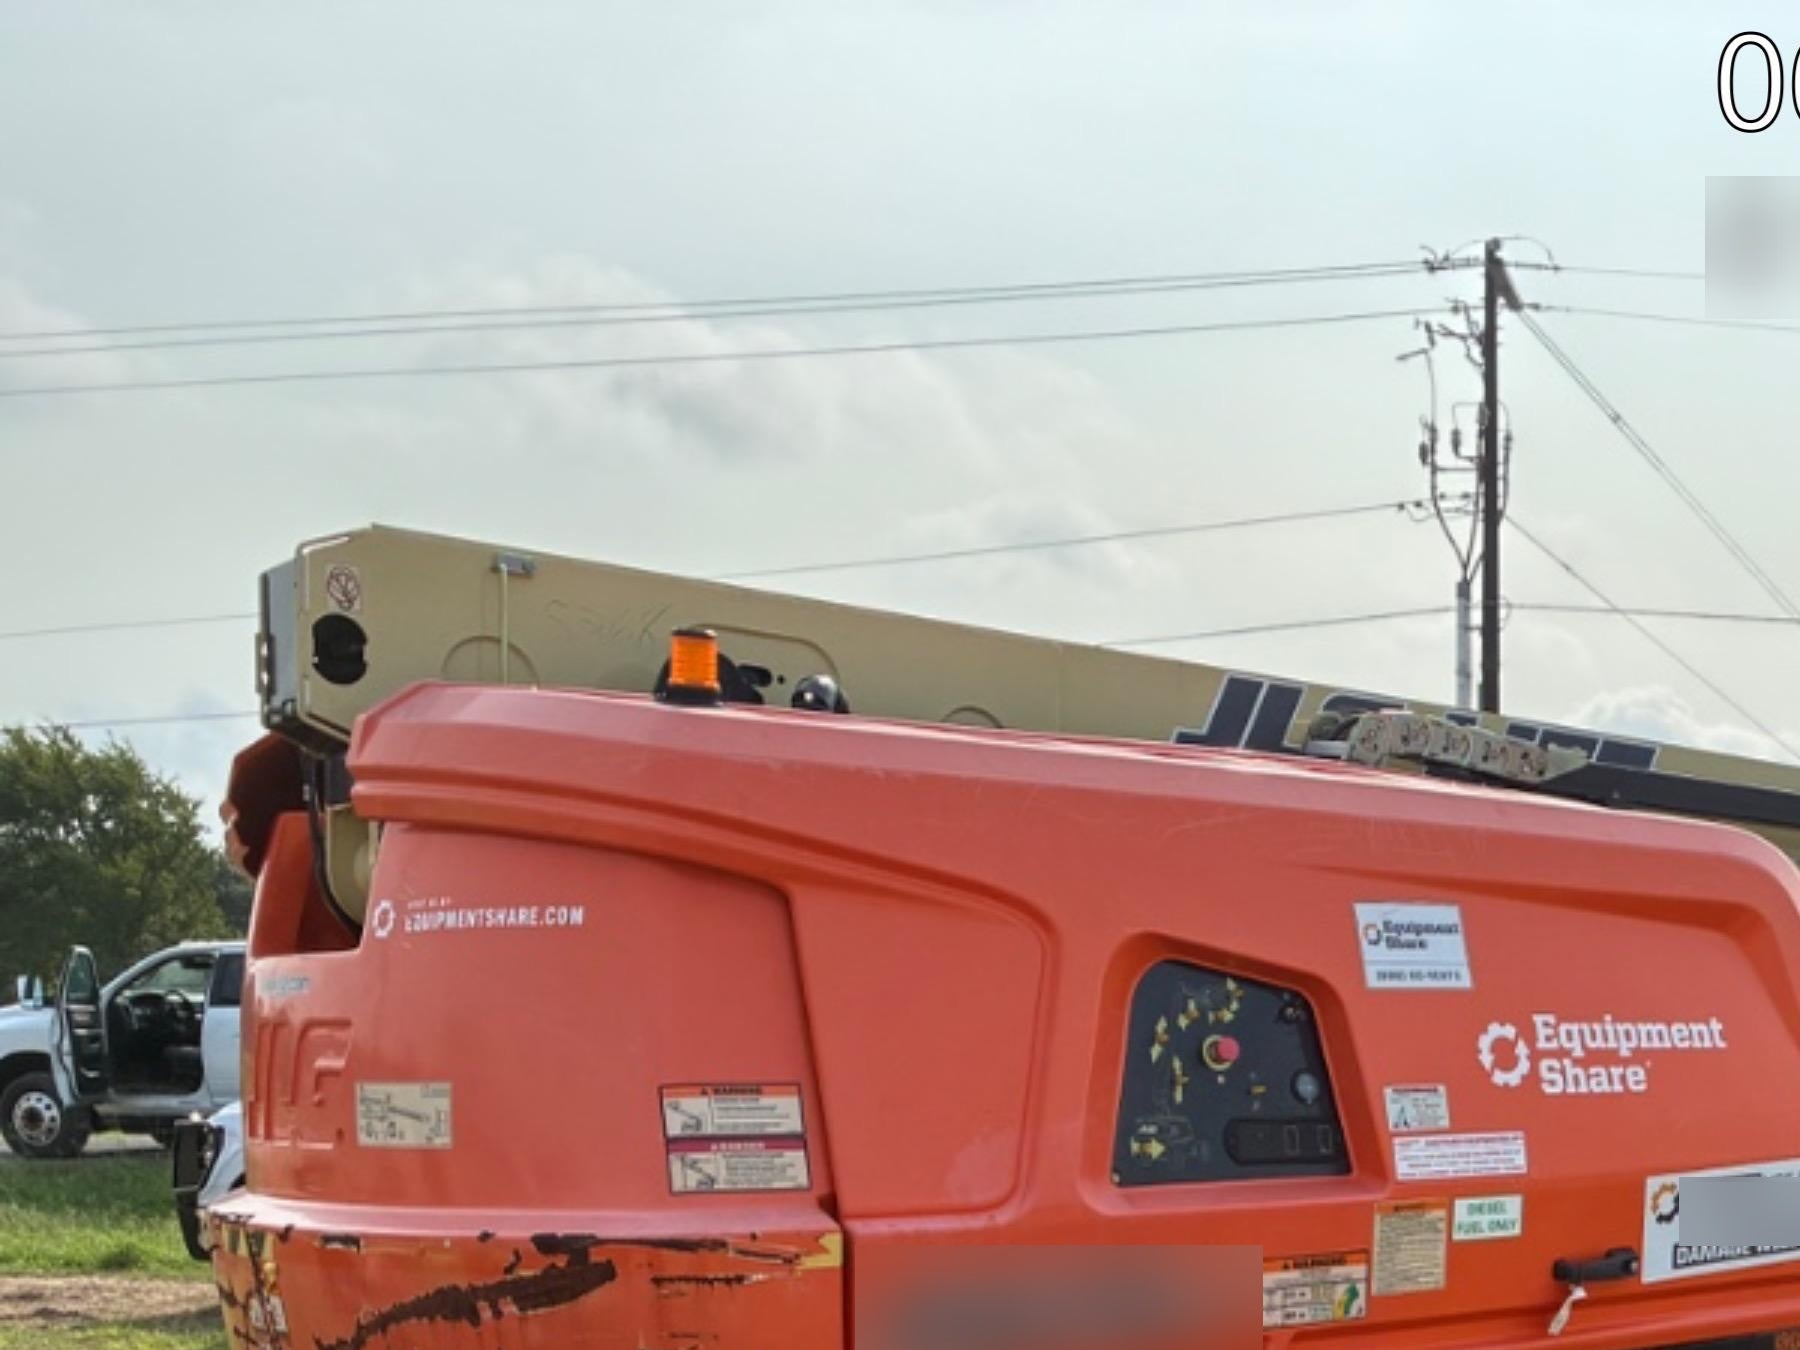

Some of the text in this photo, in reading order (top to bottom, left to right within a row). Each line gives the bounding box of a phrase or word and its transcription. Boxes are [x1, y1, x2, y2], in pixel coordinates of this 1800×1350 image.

[404, 905, 585, 933] EQUIPMENTSHARE.COM
[1531, 1013, 1728, 1057] Equipment
[1538, 1058, 1649, 1094] Share
